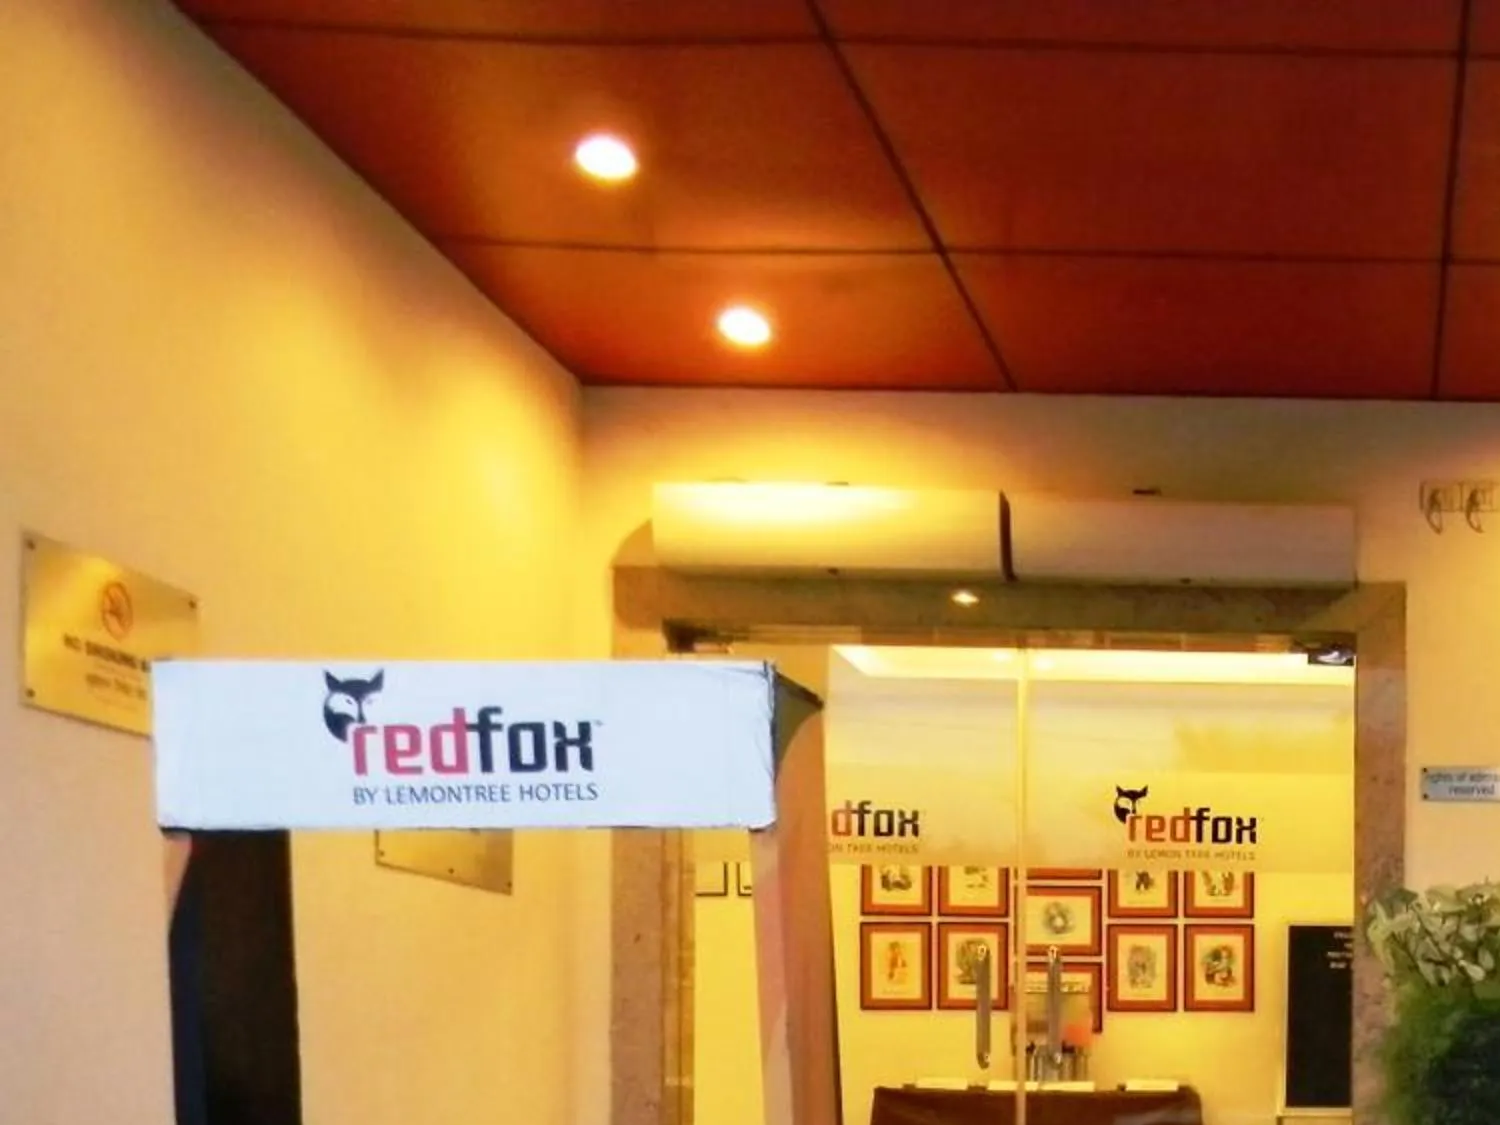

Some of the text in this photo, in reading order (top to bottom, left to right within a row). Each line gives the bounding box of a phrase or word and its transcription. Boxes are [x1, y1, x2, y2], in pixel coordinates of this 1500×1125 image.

[353, 706, 594, 776] redfox
[353, 786, 378, 805] BY
[519, 783, 599, 803] HOTELS
[831, 799, 919, 837] dfox
[1128, 806, 1257, 844] redfox
